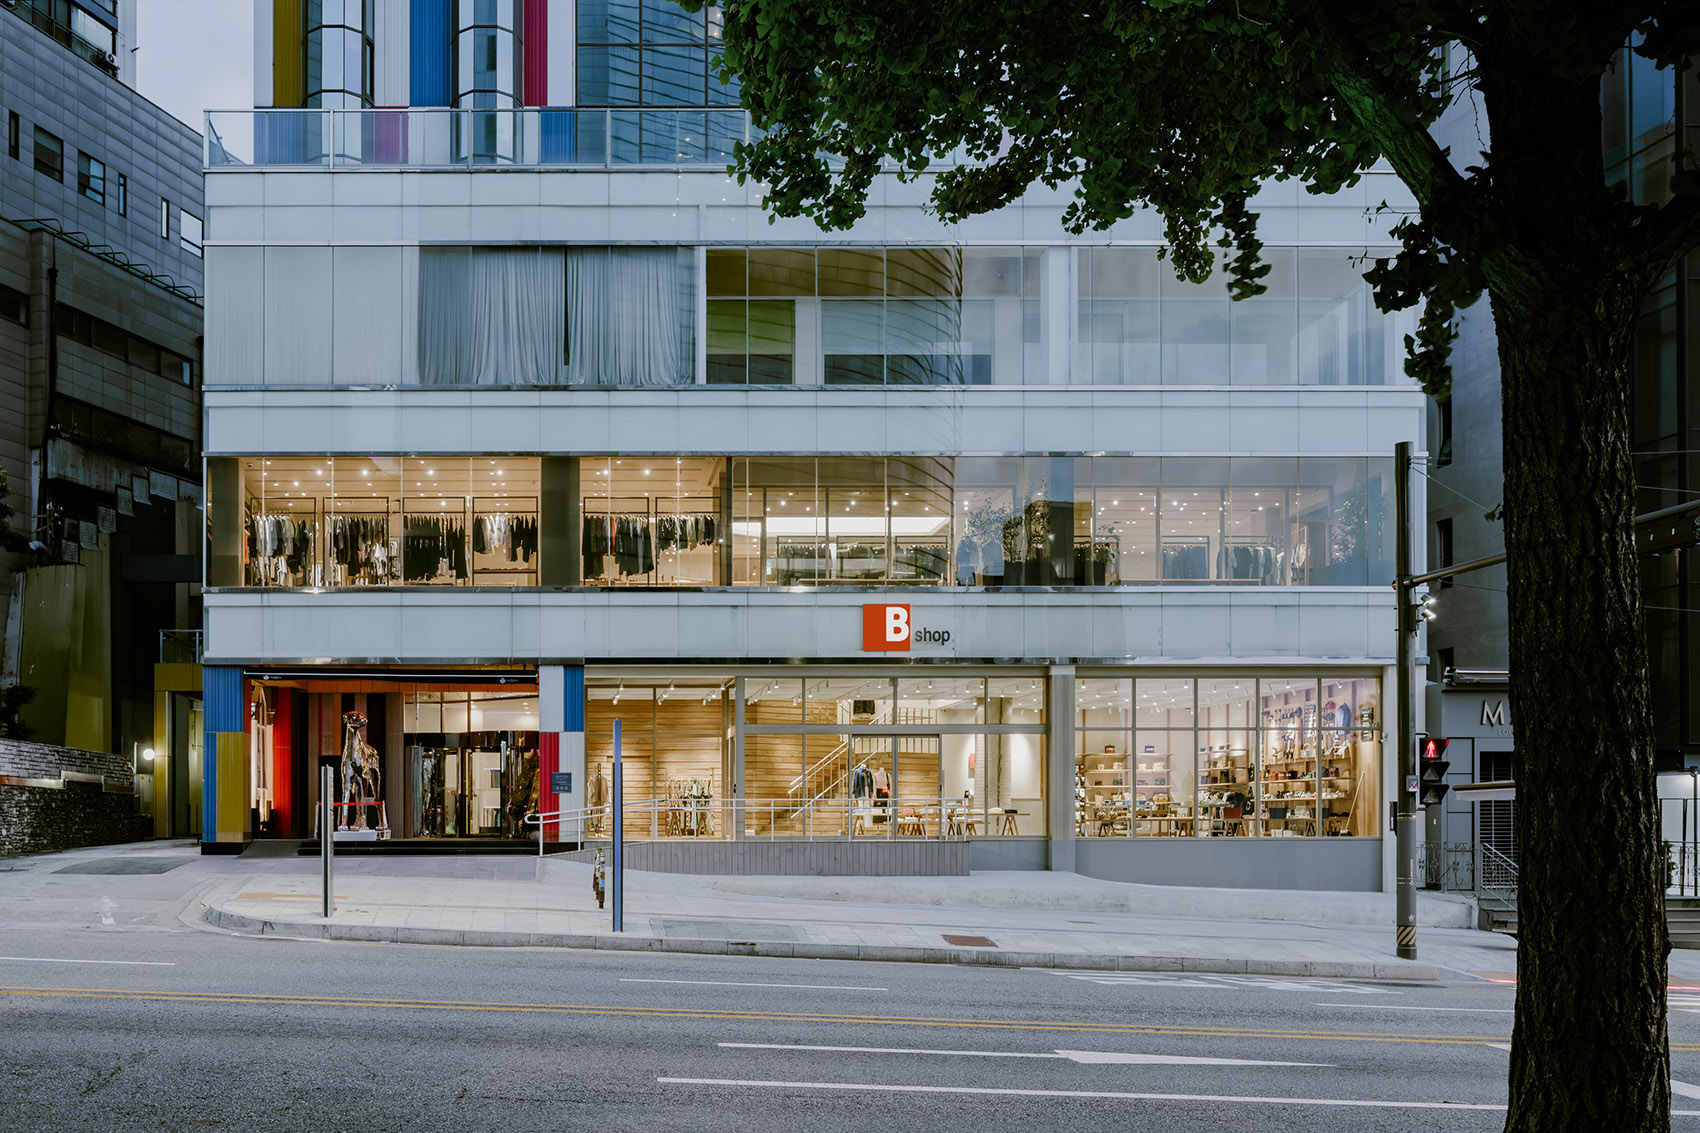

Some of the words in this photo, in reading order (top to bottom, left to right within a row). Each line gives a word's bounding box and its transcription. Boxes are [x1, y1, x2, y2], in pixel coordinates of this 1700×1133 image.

[886, 606, 910, 642] B
[914, 627, 950, 646] shop
[1480, 700, 1511, 727] M
